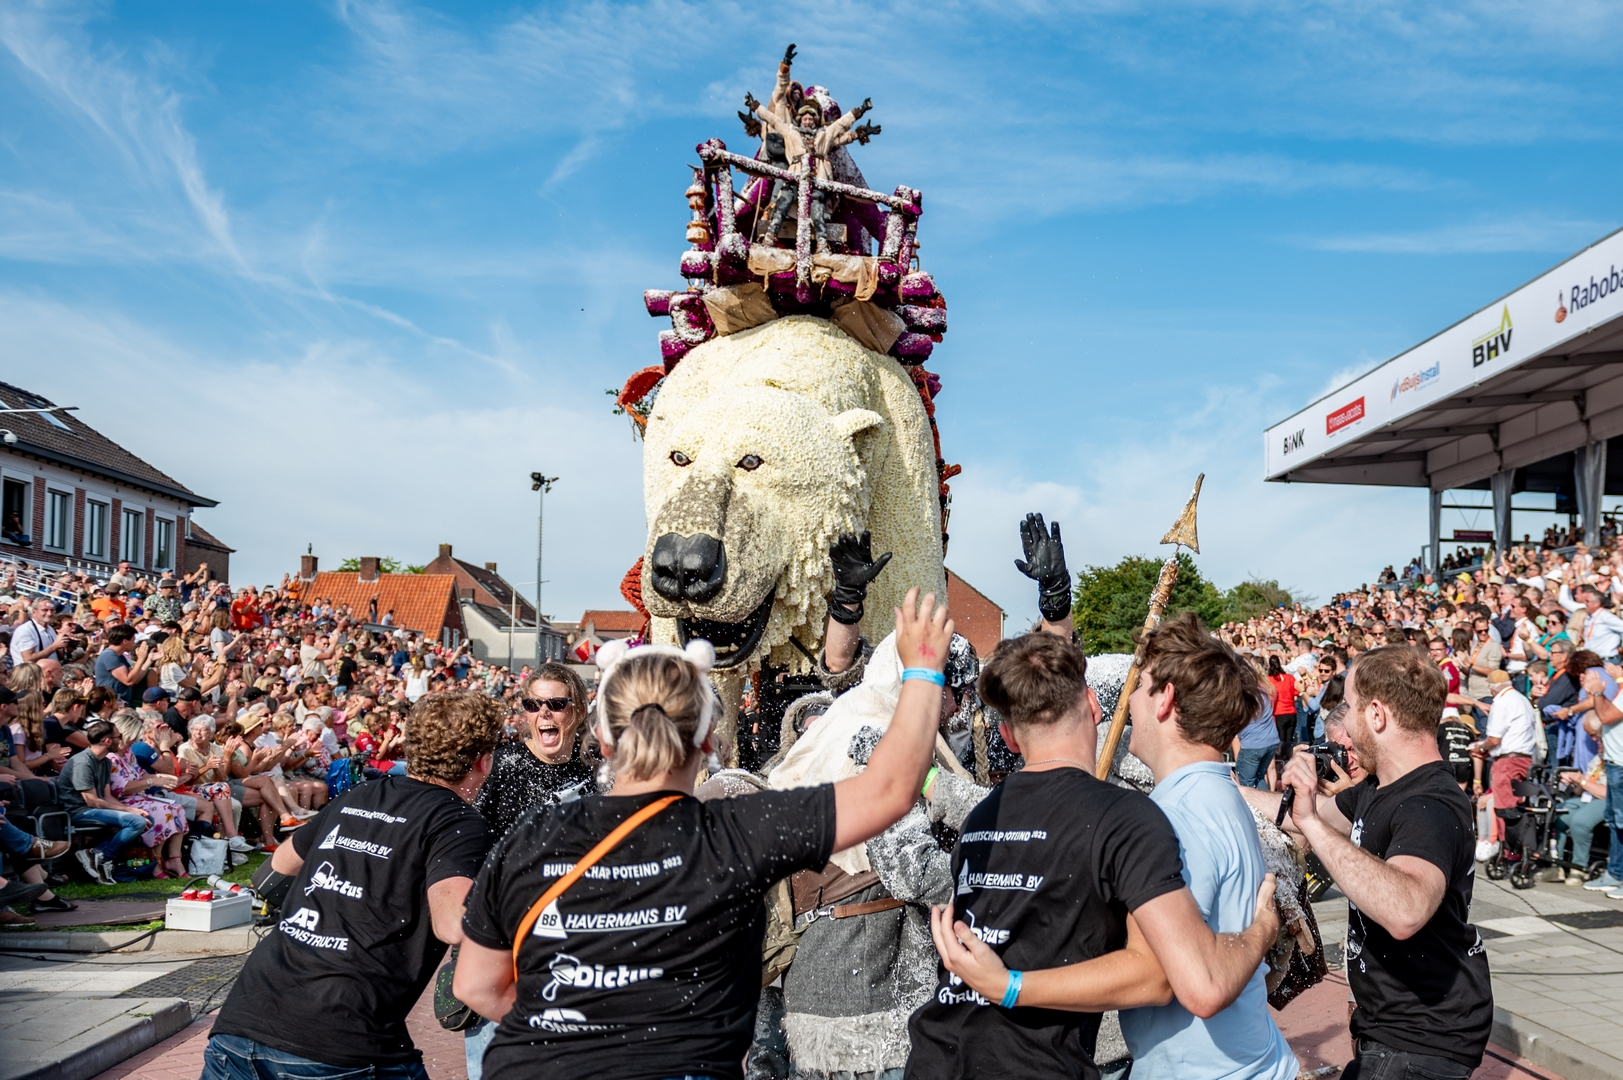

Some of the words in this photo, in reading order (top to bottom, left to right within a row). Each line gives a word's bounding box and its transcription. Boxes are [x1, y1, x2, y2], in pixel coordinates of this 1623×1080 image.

[1473, 328, 1513, 368] BHV
[377, 845, 393, 856] BV
[543, 863, 612, 880] BUURCHAP
[612, 862, 660, 880] POTEIND
[662, 855, 683, 870] 2023
[1026, 875, 1044, 890] BV
[541, 914, 558, 926] BB
[564, 909, 659, 929] HAVERMANS
[664, 905, 687, 921] BV
